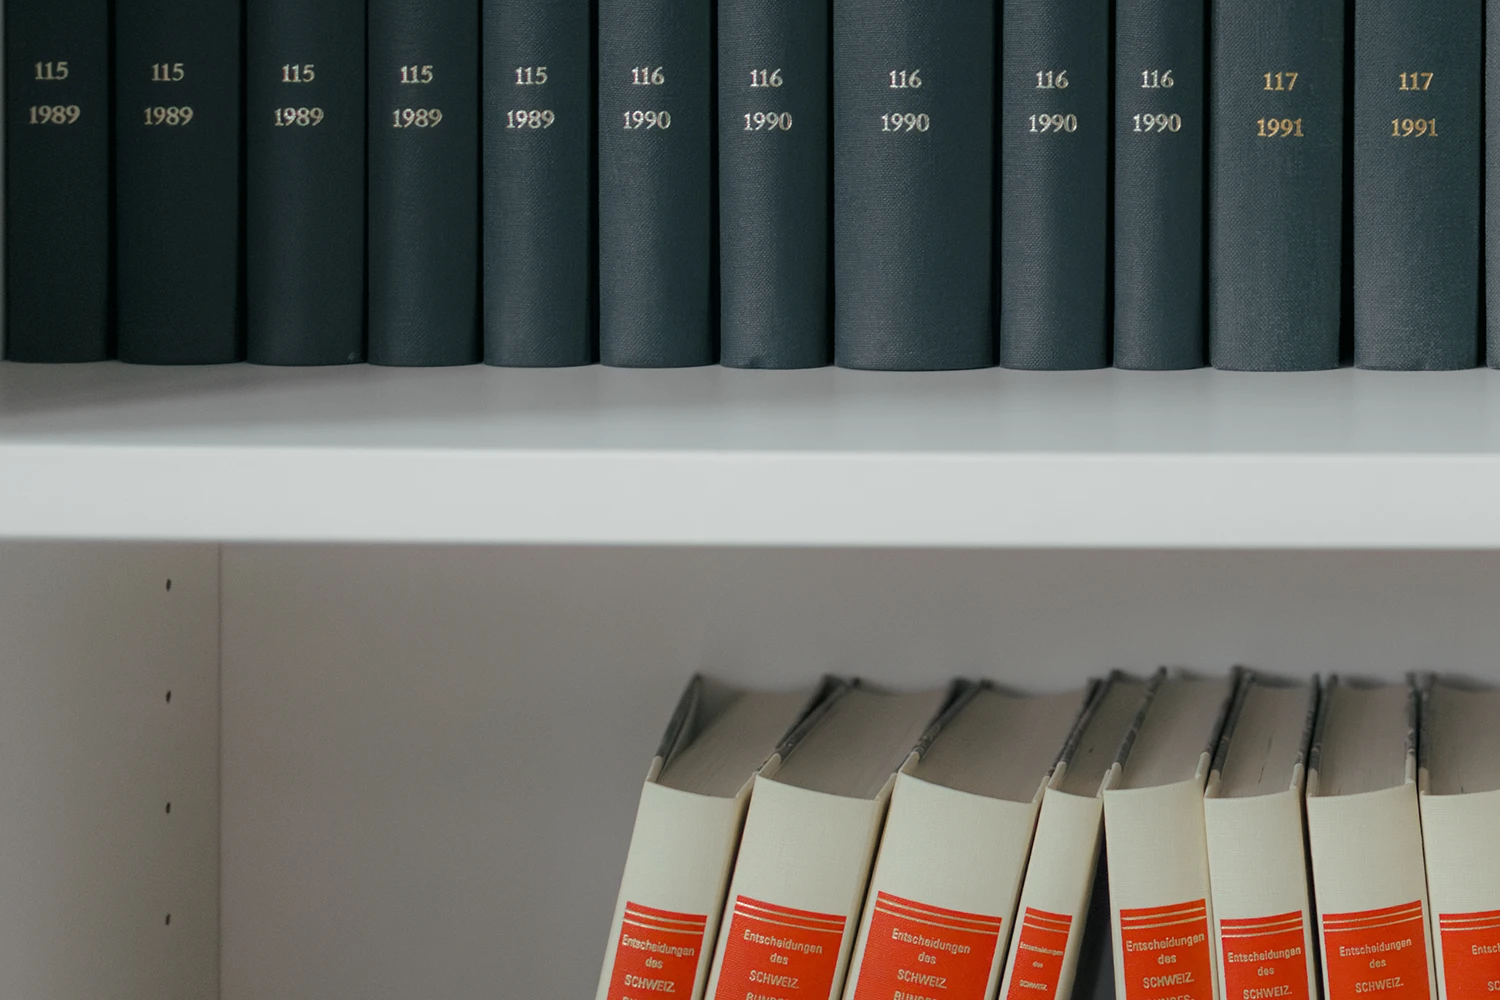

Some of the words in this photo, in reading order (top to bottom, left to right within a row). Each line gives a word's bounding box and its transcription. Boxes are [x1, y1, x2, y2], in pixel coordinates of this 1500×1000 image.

[35, 61, 69, 81] 115
[151, 62, 185, 82] 115
[281, 63, 315, 83] 115
[399, 64, 434, 84] 115
[514, 66, 548, 86] 115
[631, 66, 665, 86] 116
[749, 68, 784, 89] 116
[888, 68, 923, 89] 116
[1035, 69, 1070, 90] 116
[1140, 69, 1175, 89] 116
[1263, 71, 1299, 91] 117
[1398, 71, 1434, 92] 117
[29, 104, 81, 125] 1989
[144, 106, 194, 126] 1989
[274, 106, 325, 127] 1989
[392, 108, 443, 129] 1989
[506, 109, 556, 130] 1989
[623, 109, 672, 130] 1990
[743, 111, 793, 132] 1990
[880, 112, 931, 133] 1990
[1028, 113, 1078, 134] 1990
[1132, 112, 1182, 133] 1990
[1256, 117, 1305, 138] 1991
[1391, 117, 1439, 138] 1991
[622, 934, 695, 957] Entscheidungen
[743, 929, 822, 954] Entscheidungen
[892, 928, 970, 954] Entscheidungen
[1126, 932, 1205, 952] Entscheidungen
[1338, 938, 1412, 957] Entscheidungen
[644, 956, 664, 969] des
[769, 952, 789, 966] des
[917, 951, 937, 965] des
[1157, 953, 1177, 965] des
[1228, 945, 1301, 963] Entscheidungen
[1368, 958, 1387, 969] des
[1142, 971, 1195, 989] SCHWEIZ.
[1257, 965, 1275, 977] des
[1242, 984, 1293, 1000] SCHWEIZ.
[1354, 976, 1404, 994] SCHWEIZ.
